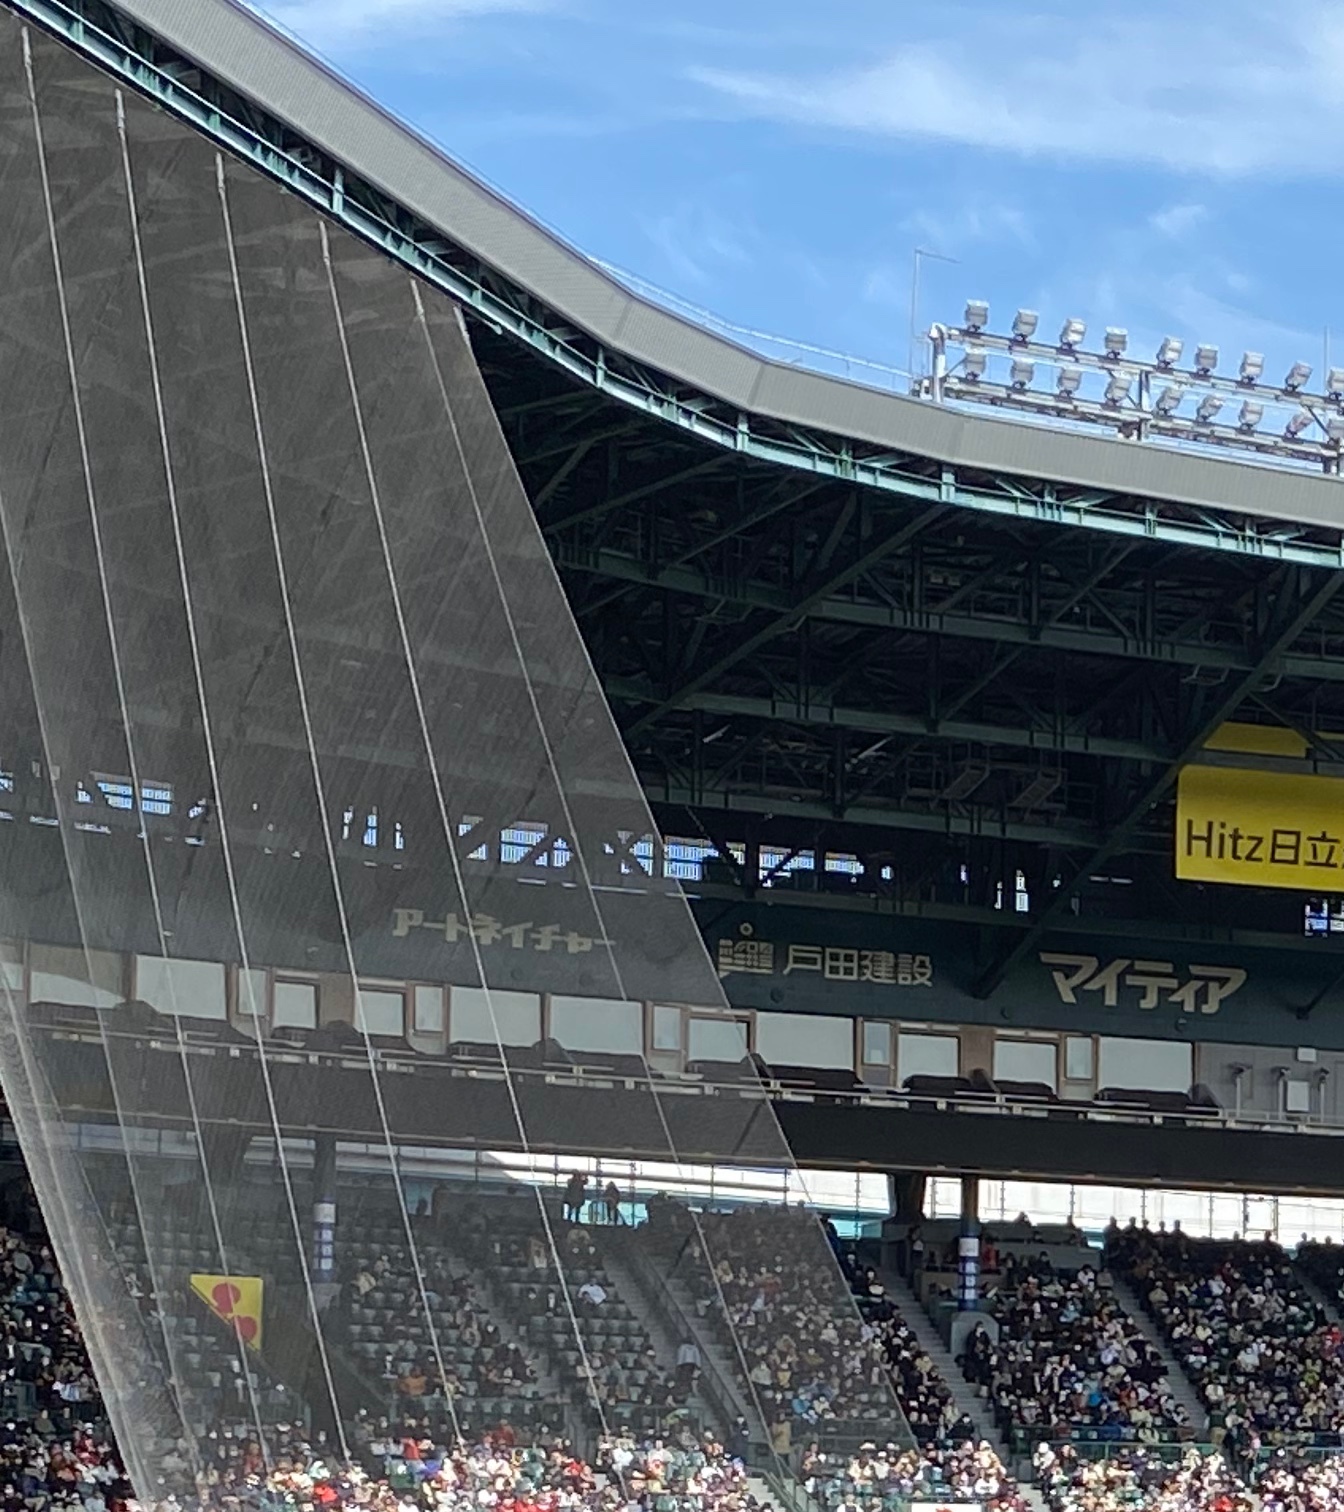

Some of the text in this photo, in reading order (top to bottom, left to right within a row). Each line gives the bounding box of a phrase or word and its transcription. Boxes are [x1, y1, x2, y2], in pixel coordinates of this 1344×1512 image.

[393, 909, 616, 953] アートネイチャー
[783, 945, 933, 988] 戸田建設
[1039, 952, 1247, 1015] マイティア
